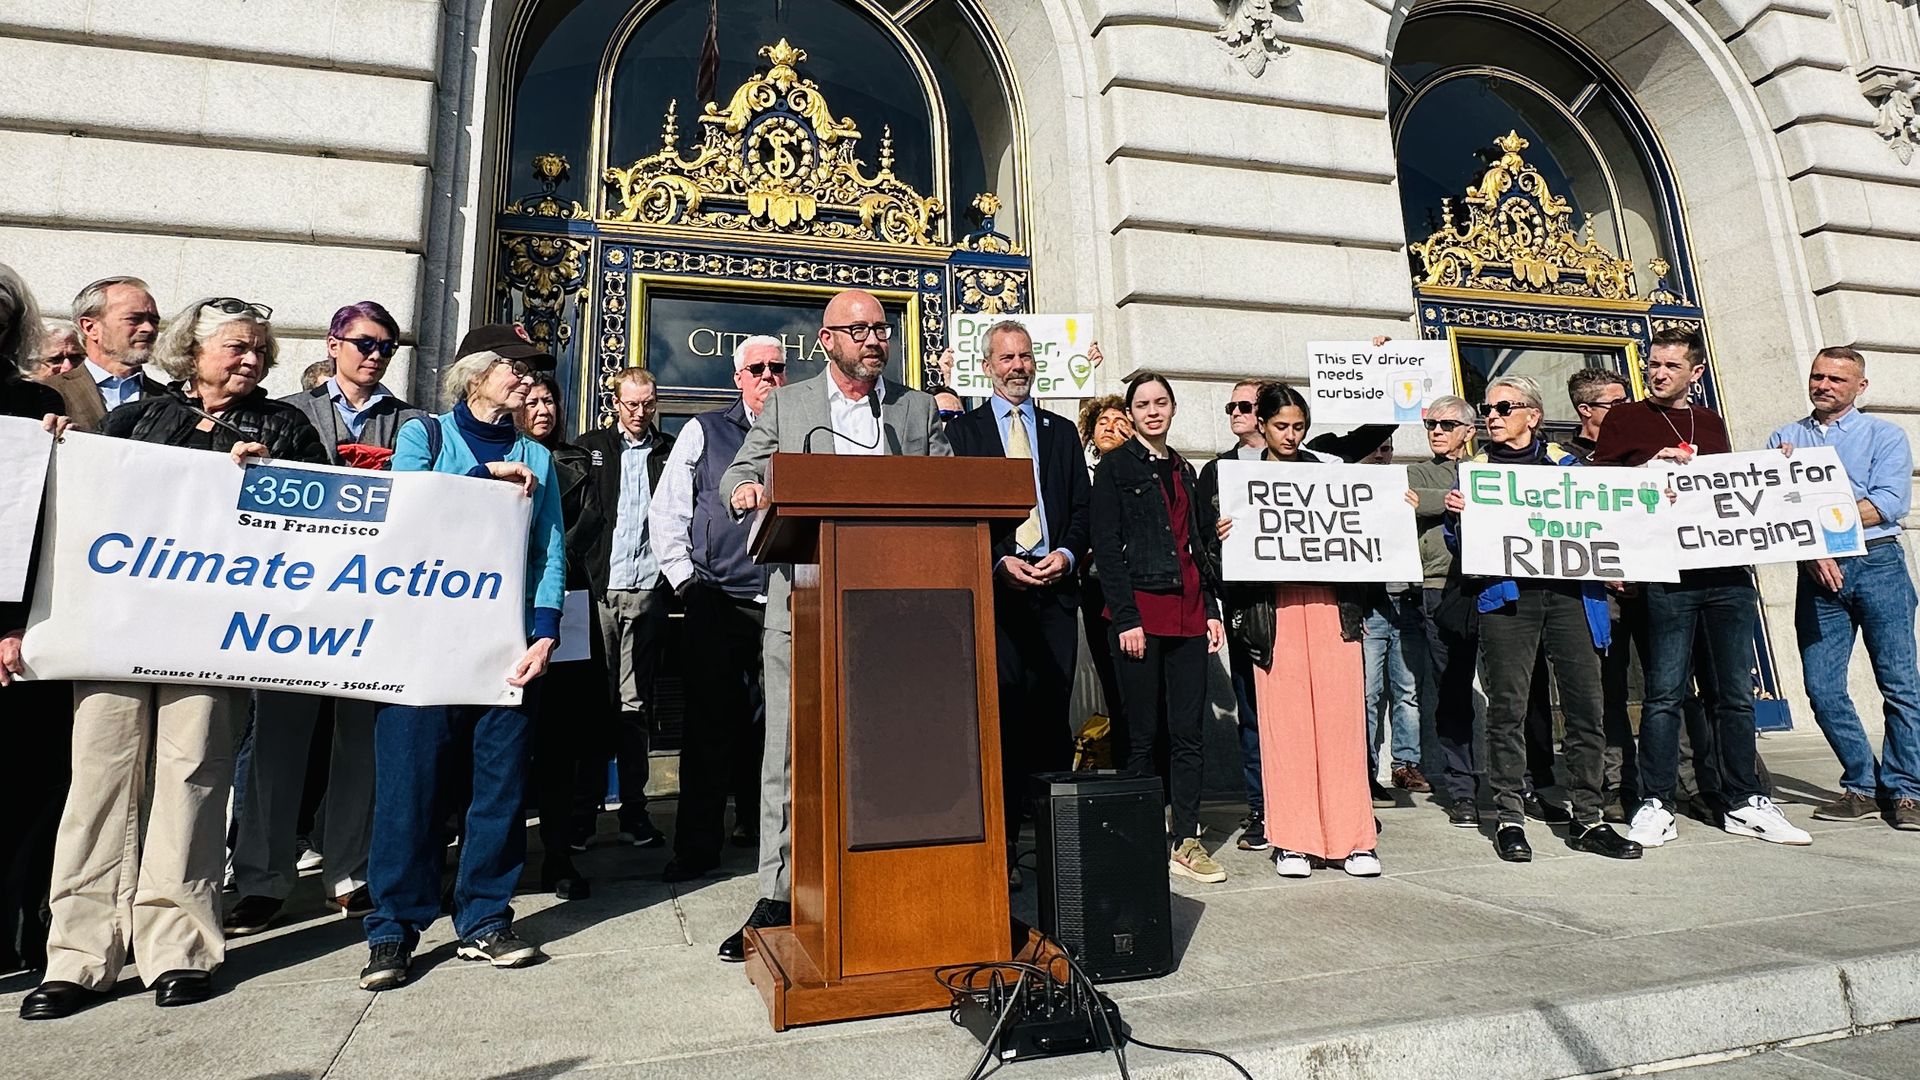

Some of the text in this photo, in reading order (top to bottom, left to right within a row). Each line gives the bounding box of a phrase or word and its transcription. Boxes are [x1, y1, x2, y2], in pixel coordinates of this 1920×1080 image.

[688, 328, 831, 361] CIT HA
[1315, 353, 1425, 366] This EV driver
[1317, 369, 1364, 380] needs
[1317, 387, 1384, 399] curbside
[254, 476, 389, 514] 350 SF
[1247, 480, 1373, 508] REV UP
[1713, 489, 1764, 519] EV
[238, 513, 379, 537] San Francisco
[1259, 508, 1363, 535] DRIVE
[1677, 519, 1816, 551] Charging
[1254, 536, 1382, 563] CLEAN!
[1503, 535, 1625, 578] RIDE
[87, 532, 503, 600] Climate Action
[220, 611, 374, 657] Now!
[132, 666, 195, 678] Because
[198, 671, 223, 680] it's
[249, 676, 330, 689] emergency
[340, 681, 405, 693] 350sf.org
